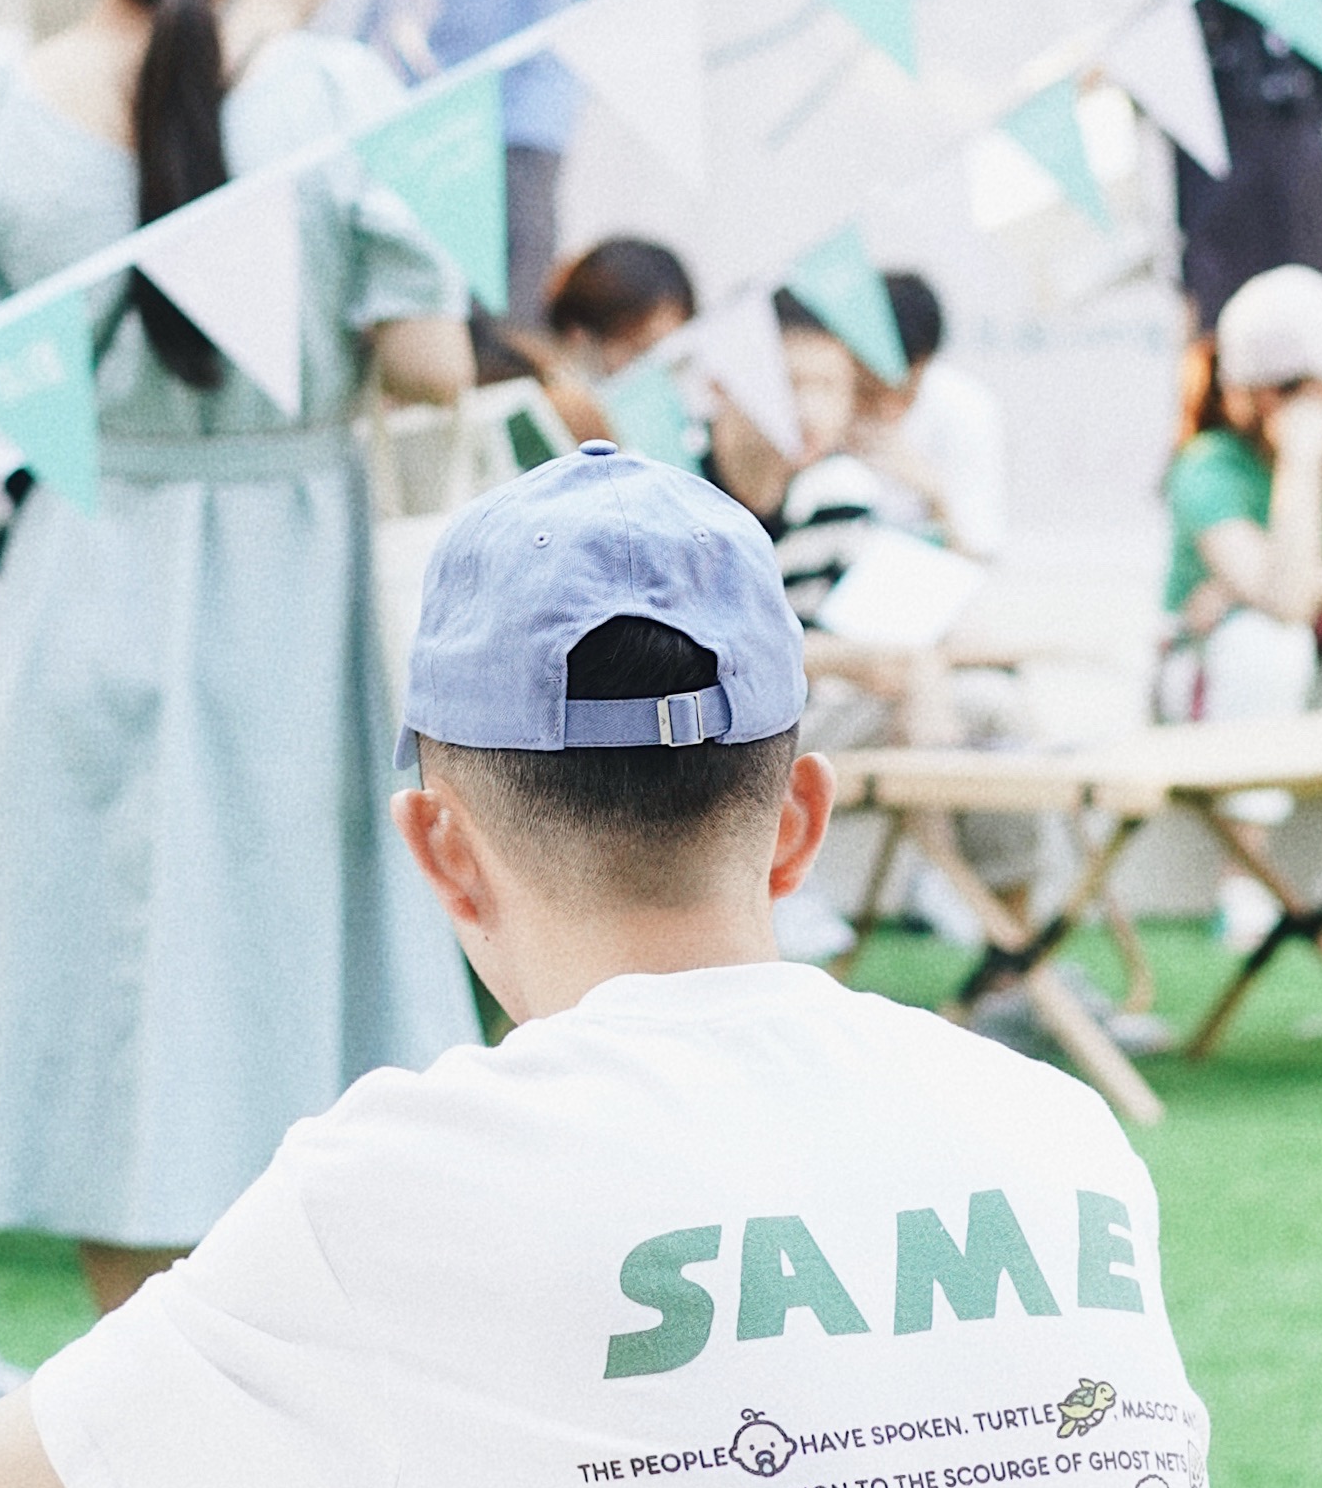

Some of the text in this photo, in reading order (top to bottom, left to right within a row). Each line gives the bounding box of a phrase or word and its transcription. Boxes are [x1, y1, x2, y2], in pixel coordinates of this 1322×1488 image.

[603, 1188, 1145, 1380] SAME
[577, 1459, 625, 1483] THE
[630, 1447, 728, 1477] PEOPLE
[799, 1428, 866, 1454] HAVE
[871, 1416, 969, 1445] SPOKEN.
[973, 1404, 1056, 1431] TURTLE
[944, 1456, 1050, 1488] SCOURGE
[1055, 1453, 1082, 1473] OF
[1089, 1450, 1149, 1472] GHOST
[1155, 1452, 1188, 1473] NETS
